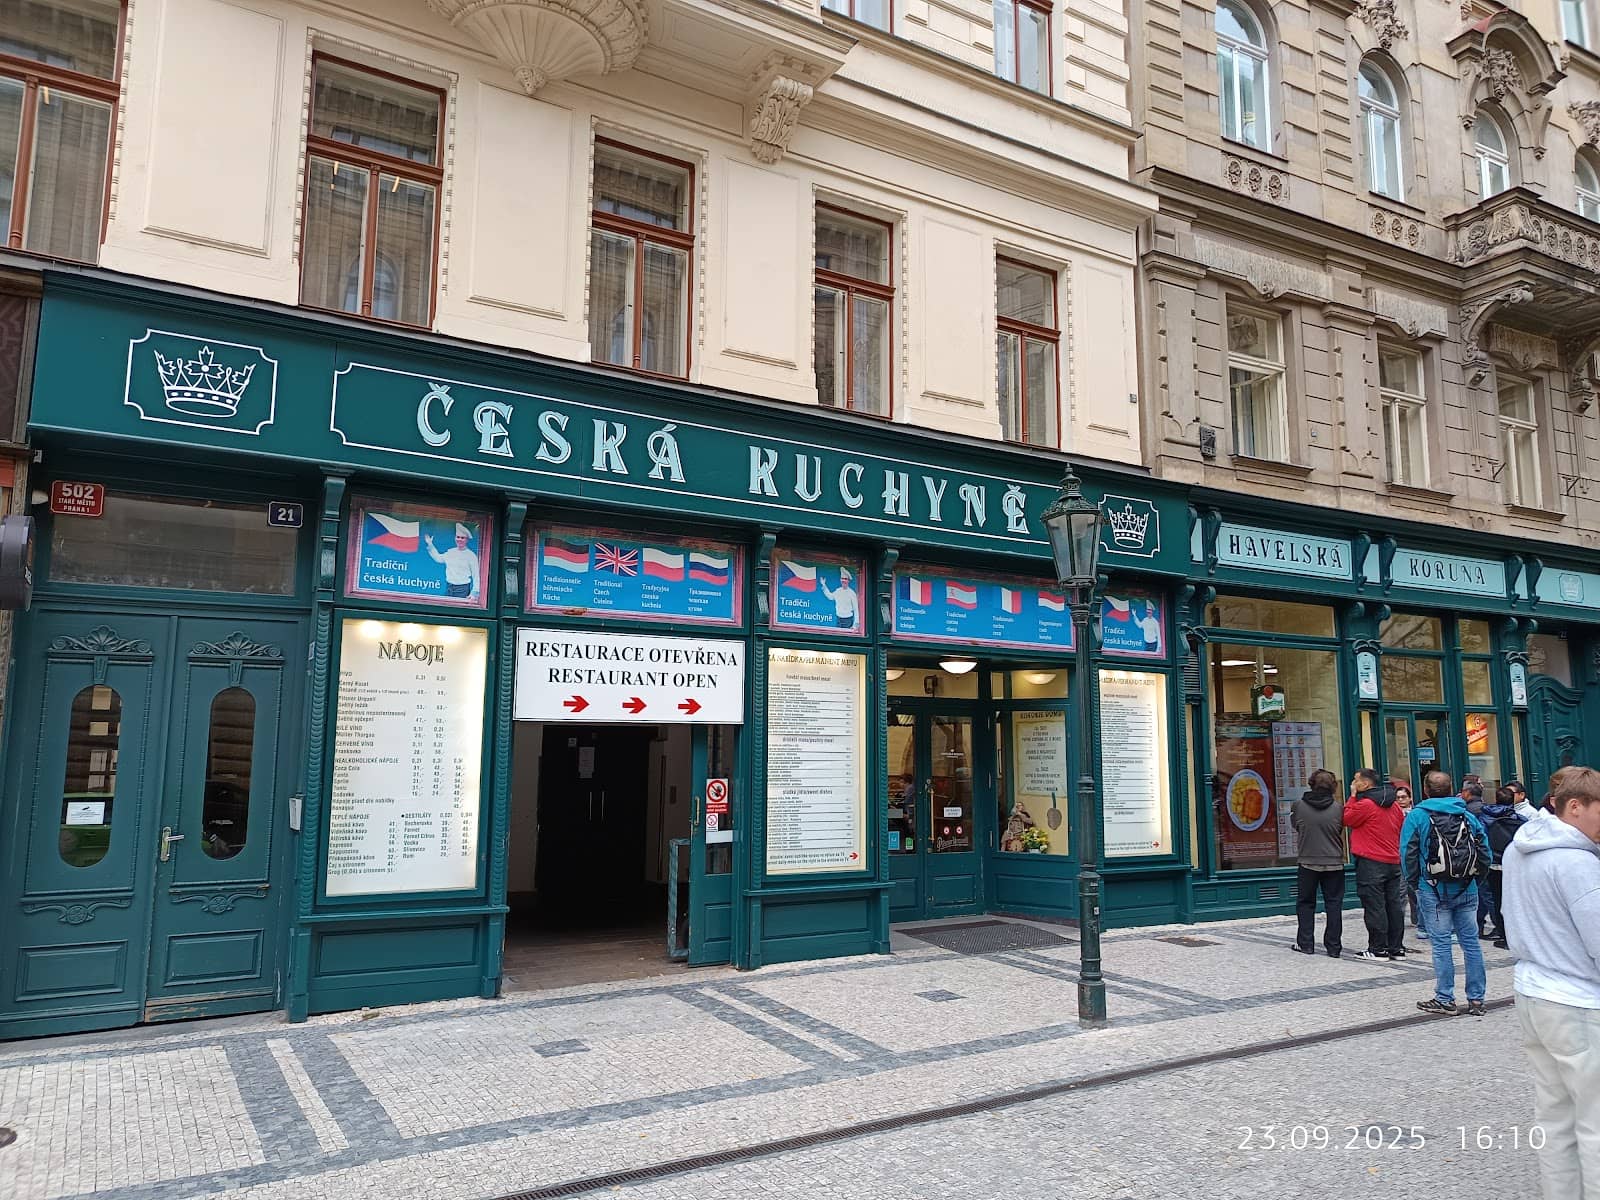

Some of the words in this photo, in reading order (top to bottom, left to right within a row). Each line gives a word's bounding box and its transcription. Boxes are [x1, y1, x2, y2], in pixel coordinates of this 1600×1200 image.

[416, 382, 686, 483] ČESKÁ
[749, 446, 1030, 534] KUCHYNĚ
[62, 484, 94, 499] 502
[277, 508, 294, 522] 21
[1229, 534, 1344, 569] HAVELSKÁ
[365, 558, 408, 570] Tradiční
[1409, 557, 1486, 586] KORUNA
[364, 572, 394, 584] česká
[398, 575, 440, 589] kuchyně
[594, 580, 622, 588] Traditional
[780, 597, 810, 608] Tradiční
[780, 610, 801, 618] česká
[804, 611, 833, 622] kuchyně
[1104, 626, 1125, 635] Tradiční
[1104, 636, 1121, 645] česká
[1121, 637, 1142, 647] kuchyně
[378, 640, 444, 665] NÁPOJE
[526, 640, 644, 661] RESTAURACE
[650, 647, 738, 666] OTEVŘENA
[548, 668, 668, 687] RESTAURANT
[673, 673, 718, 688] OPEN
